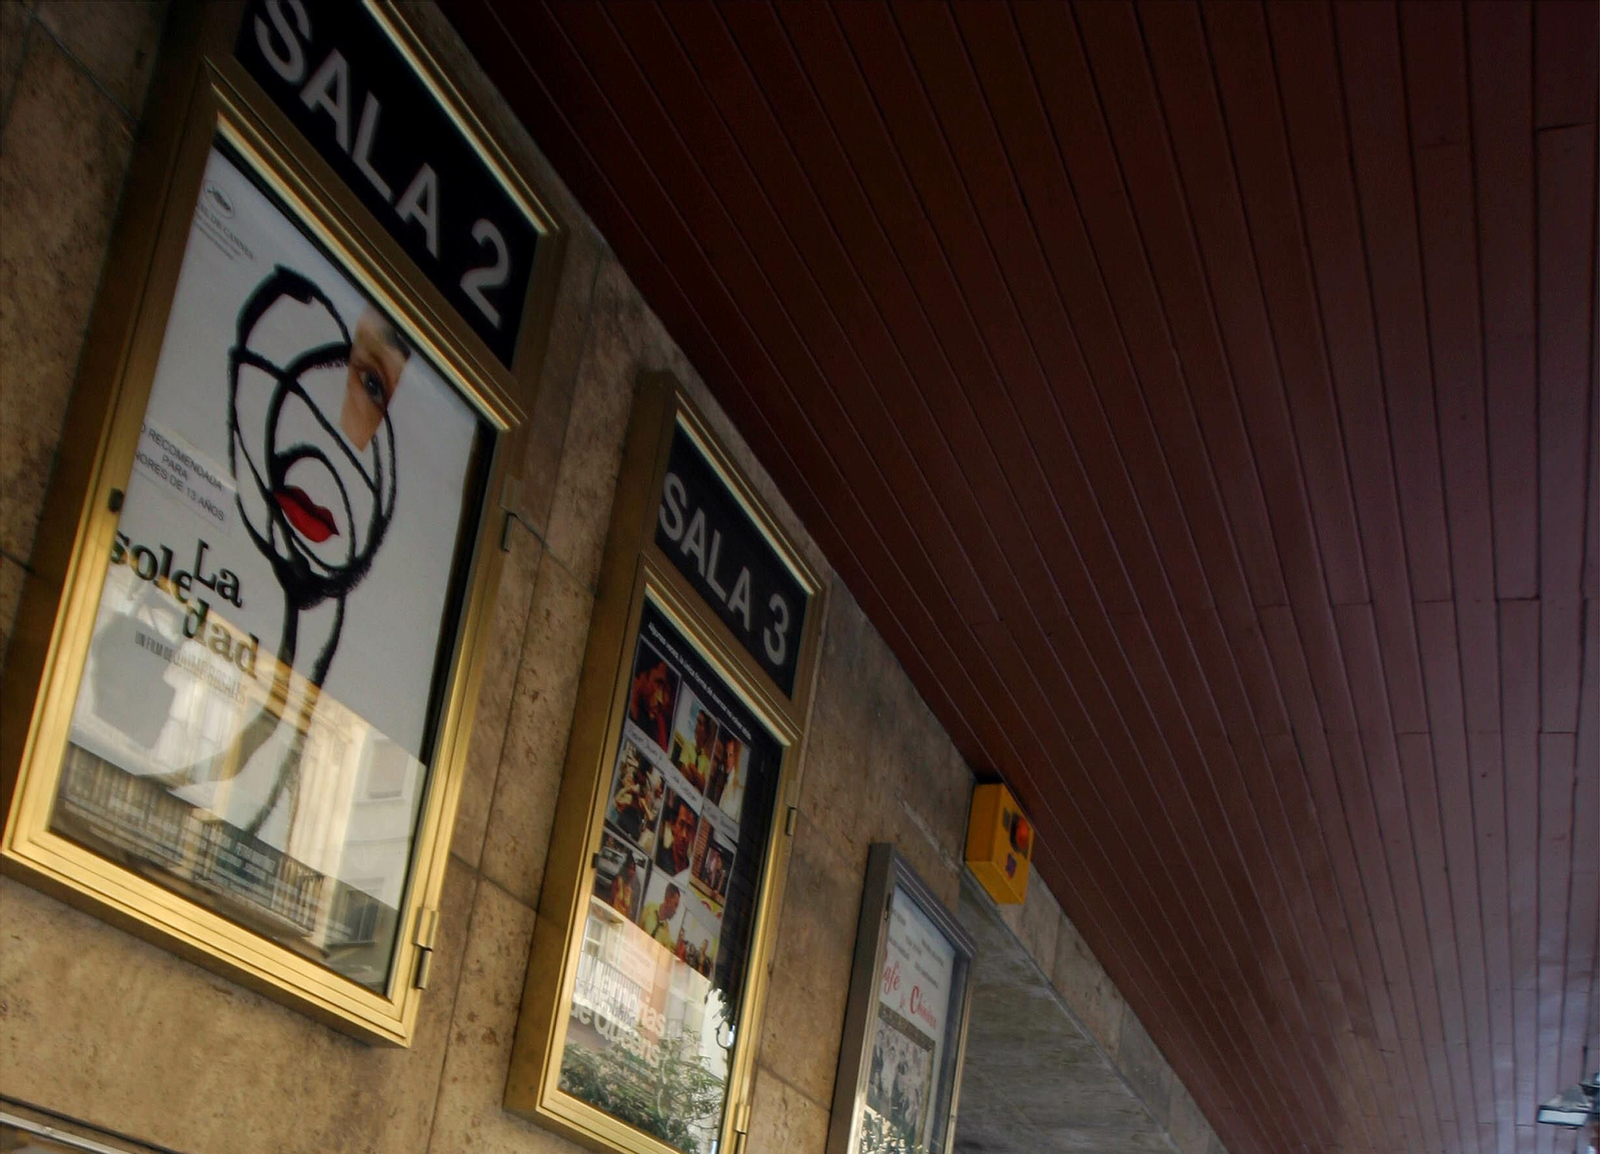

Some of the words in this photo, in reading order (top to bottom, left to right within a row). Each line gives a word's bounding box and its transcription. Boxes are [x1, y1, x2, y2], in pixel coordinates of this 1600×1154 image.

[254, 0, 441, 263] SALA
[459, 218, 510, 330] 2
[149, 428, 222, 490] RECOMENDADA
[163, 454, 188, 480] PARA
[169, 475, 184, 491] DE
[186, 487, 197, 502] 13
[199, 497, 224, 521] AÑOS
[193, 538, 242, 608] La
[659, 472, 750, 632] SALA
[763, 593, 790, 666] 3
[183, 598, 259, 680] dad
